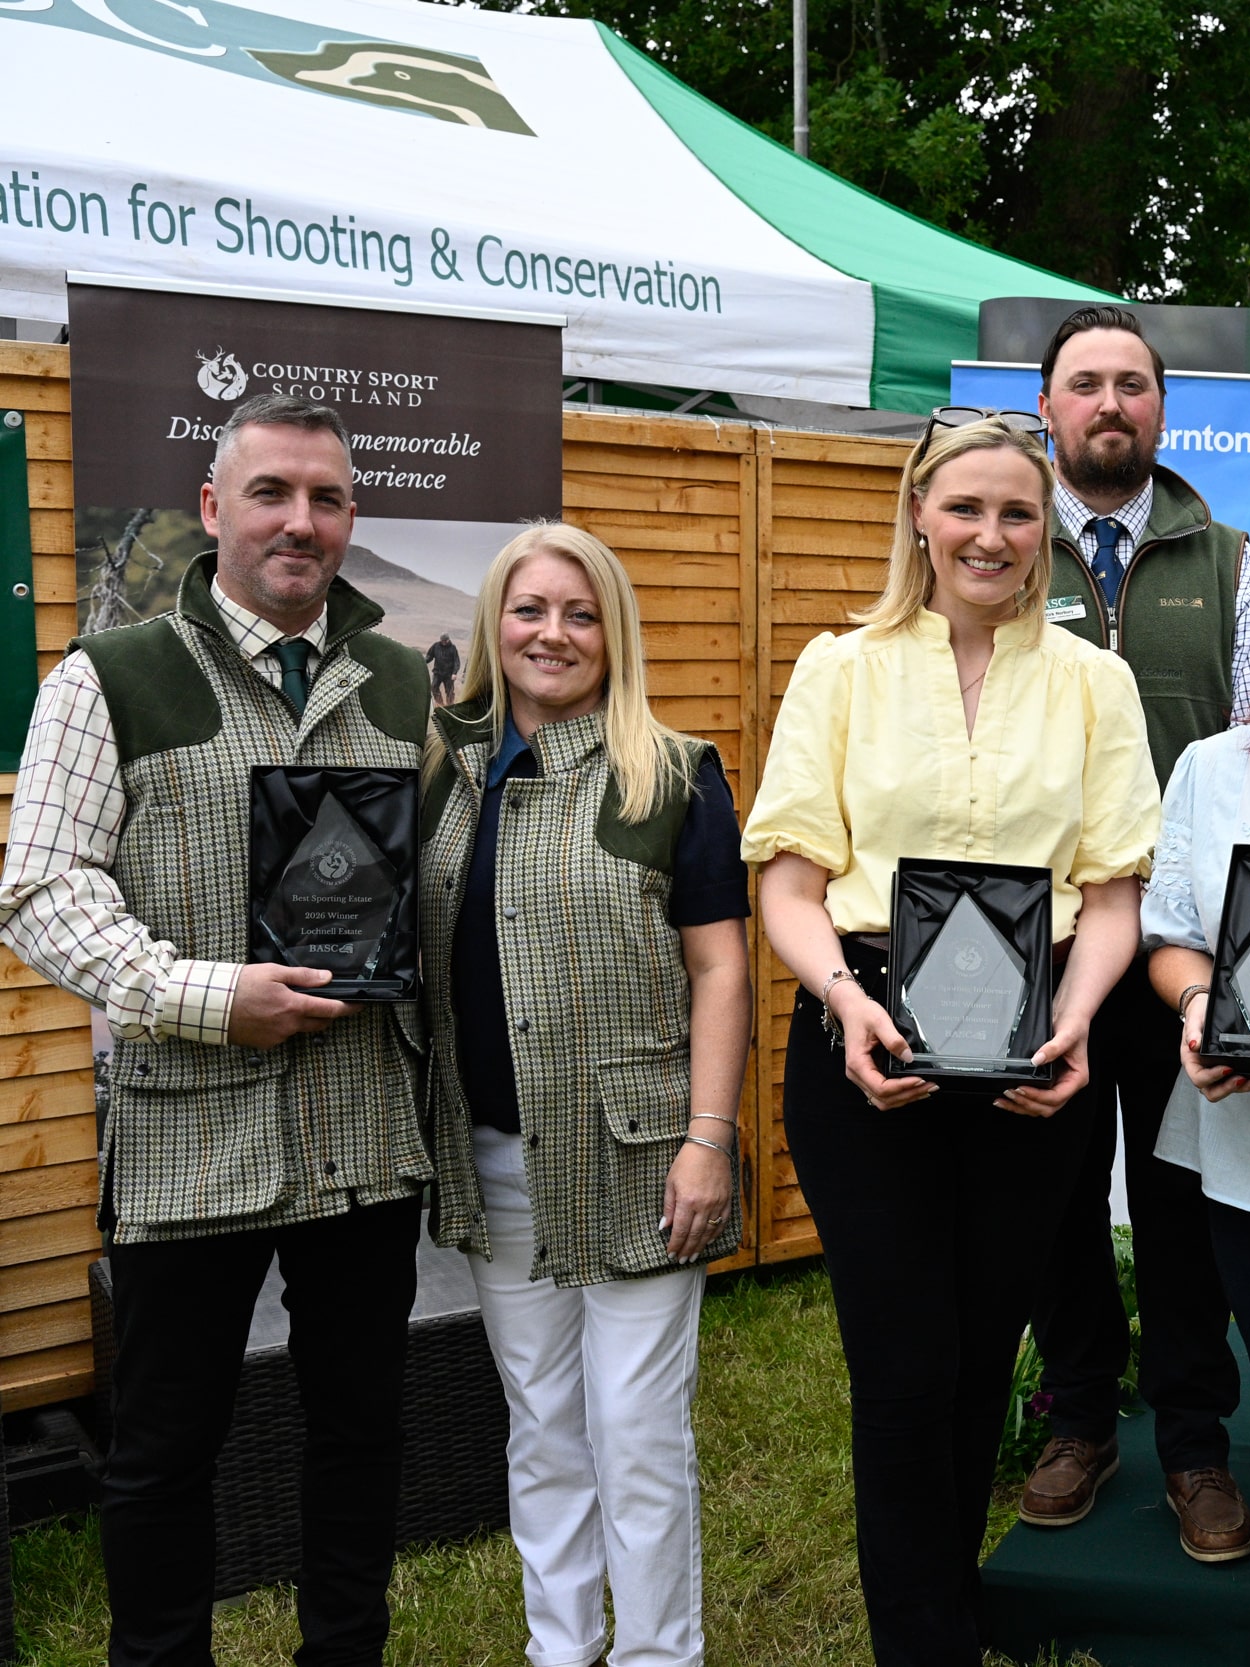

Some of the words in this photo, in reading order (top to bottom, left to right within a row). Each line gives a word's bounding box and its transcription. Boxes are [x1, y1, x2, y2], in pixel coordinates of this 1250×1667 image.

[127, 183, 196, 247] for
[214, 197, 413, 288] Shooting
[431, 227, 464, 281] &
[476, 235, 722, 314] Conservation
[252, 363, 363, 384] COUNTRY
[368, 371, 439, 391] SPORT
[271, 383, 422, 407] SCOTLAND
[166, 416, 224, 441] Disc
[351, 433, 482, 457] memorable
[352, 465, 447, 490] perience
[1045, 597, 1067, 609] ASC
[1160, 597, 1189, 607] BASC
[292, 894, 309, 902] Best
[311, 894, 347, 904] Sporting
[348, 895, 372, 903] Estate
[327, 912, 359, 920] Winner
[301, 927, 336, 935] Lochnell
[338, 928, 363, 936] Estate
[309, 944, 339, 953] BASC
